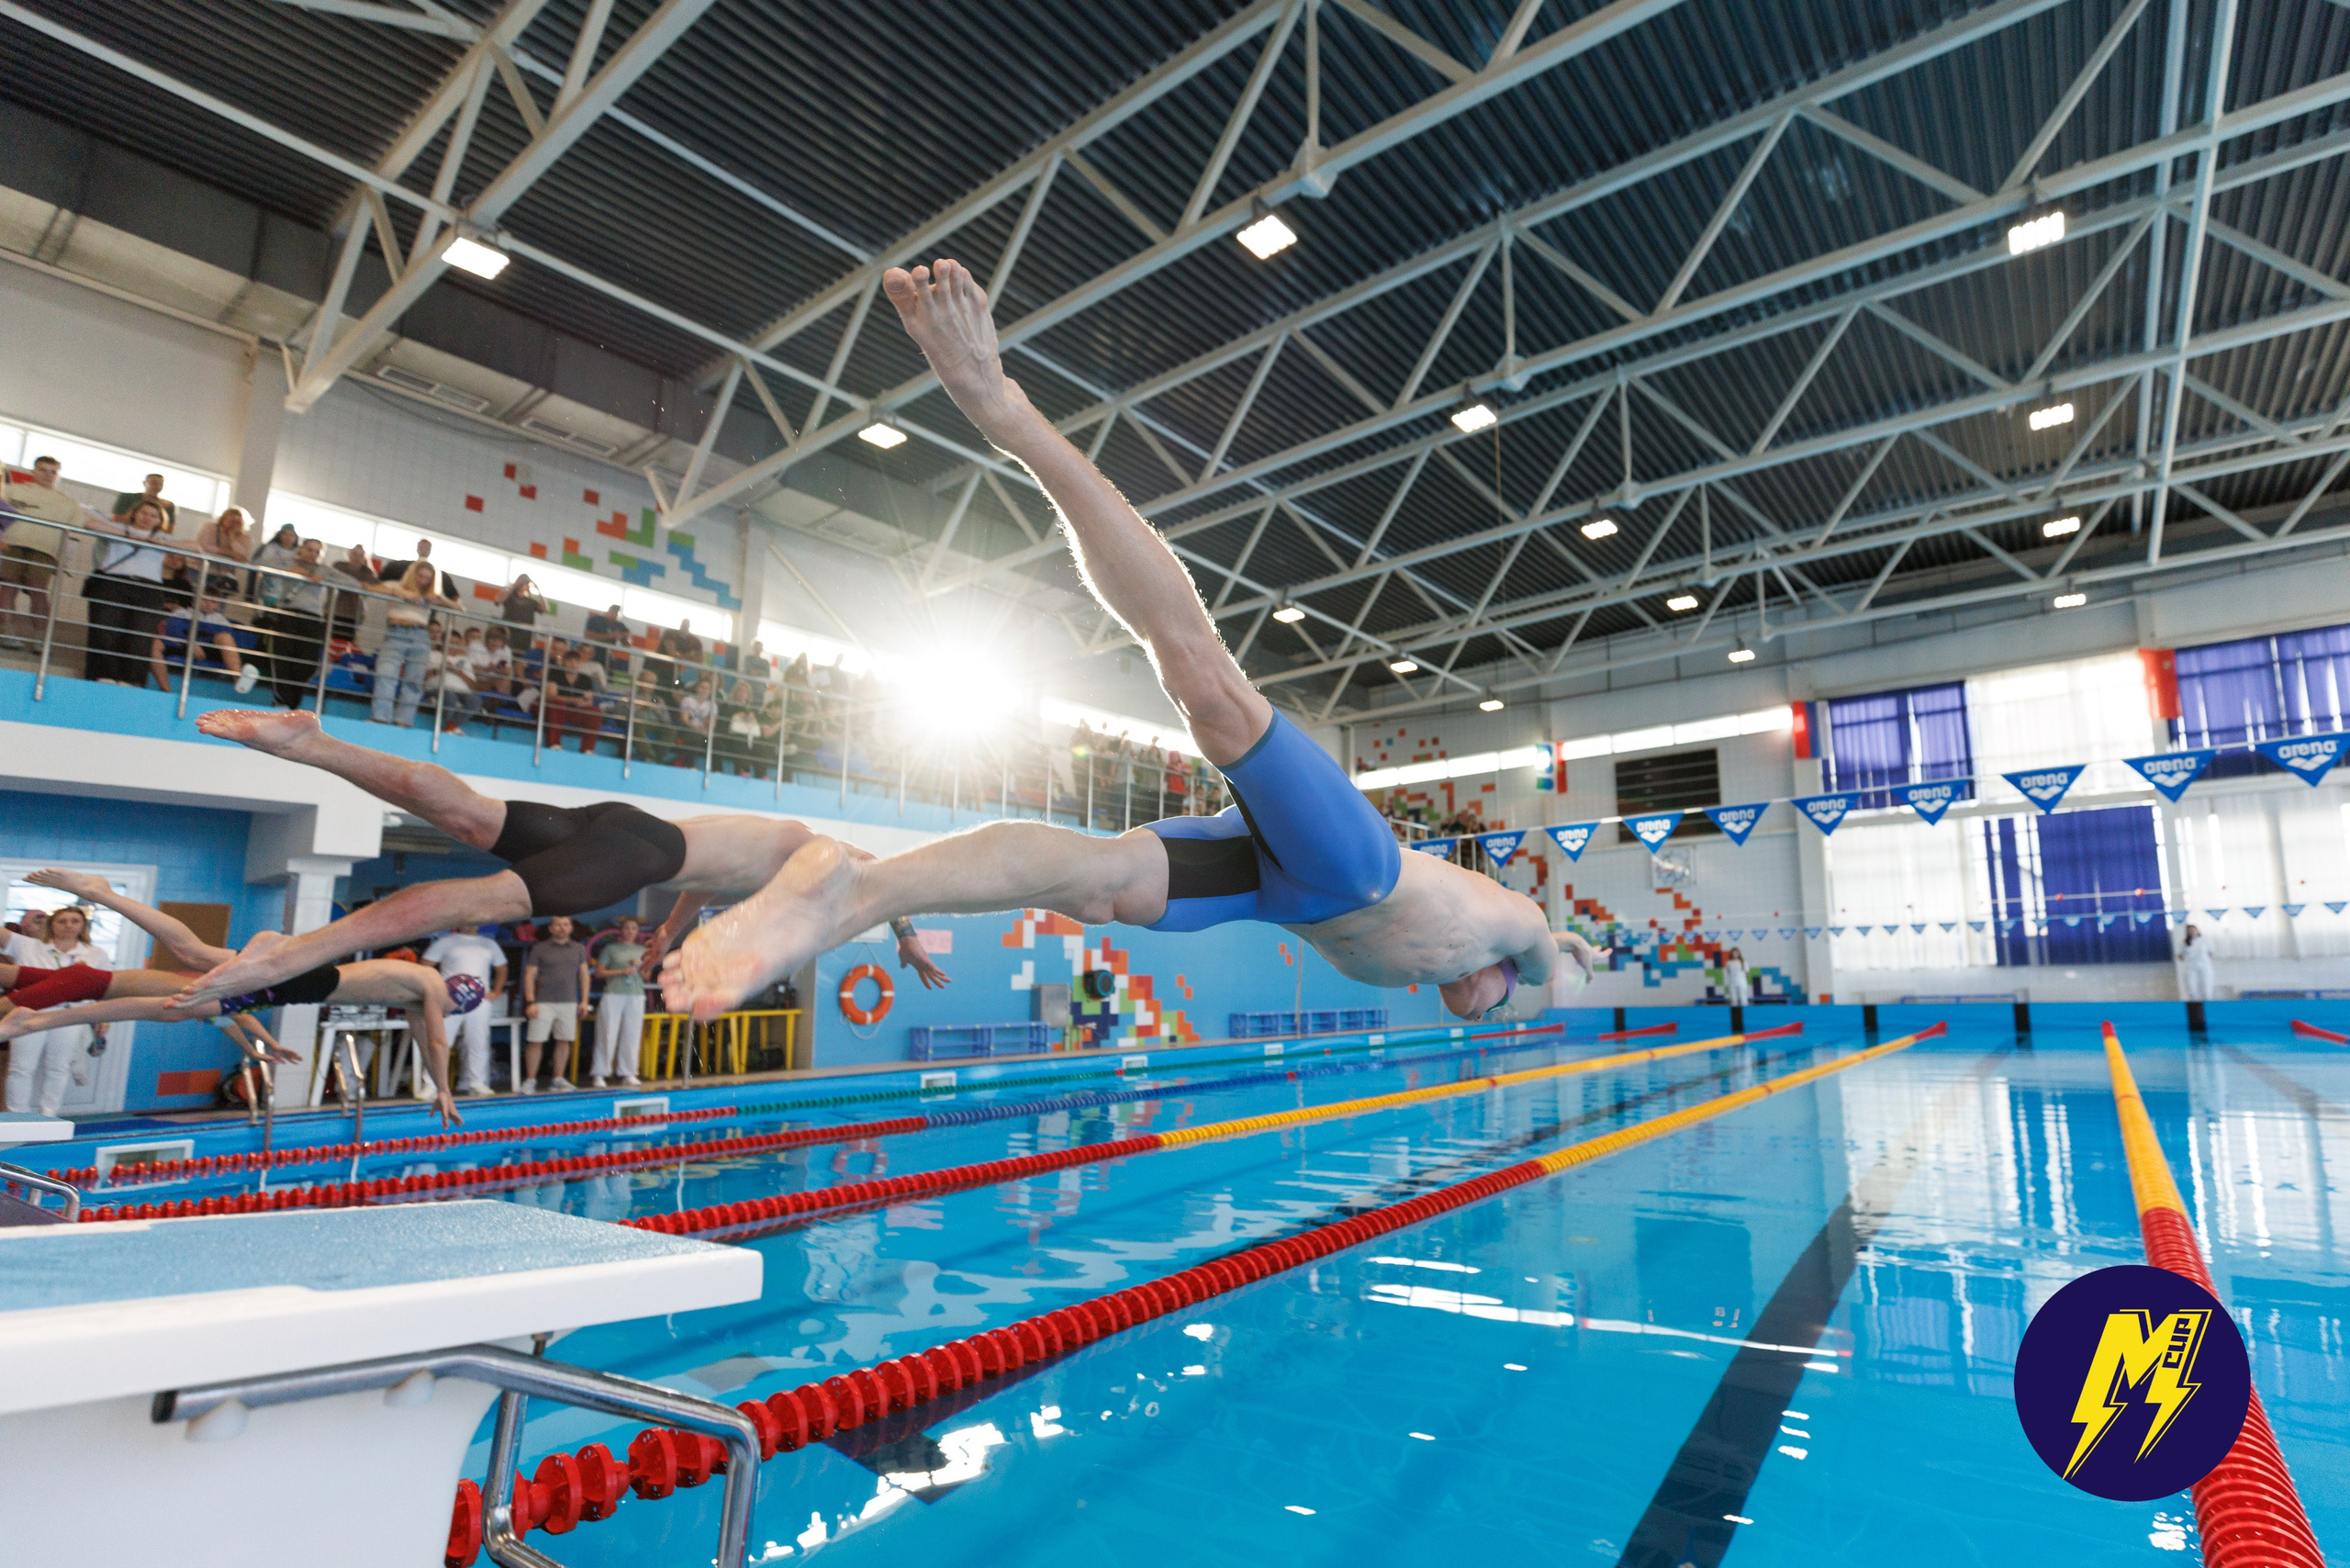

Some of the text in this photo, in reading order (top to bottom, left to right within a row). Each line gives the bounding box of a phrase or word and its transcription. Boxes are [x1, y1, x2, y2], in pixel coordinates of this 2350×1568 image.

[2277, 740, 2337, 758] arena
[2143, 756, 2197, 775] arena
[2020, 771, 2068, 789] arena
[1908, 786, 1952, 802] arena
[1807, 798, 1846, 814] arena
[1718, 809, 1755, 823] arena
[1636, 819, 1671, 833] arena
[1486, 836, 1516, 848] arena
[1557, 828, 1588, 841] arena
